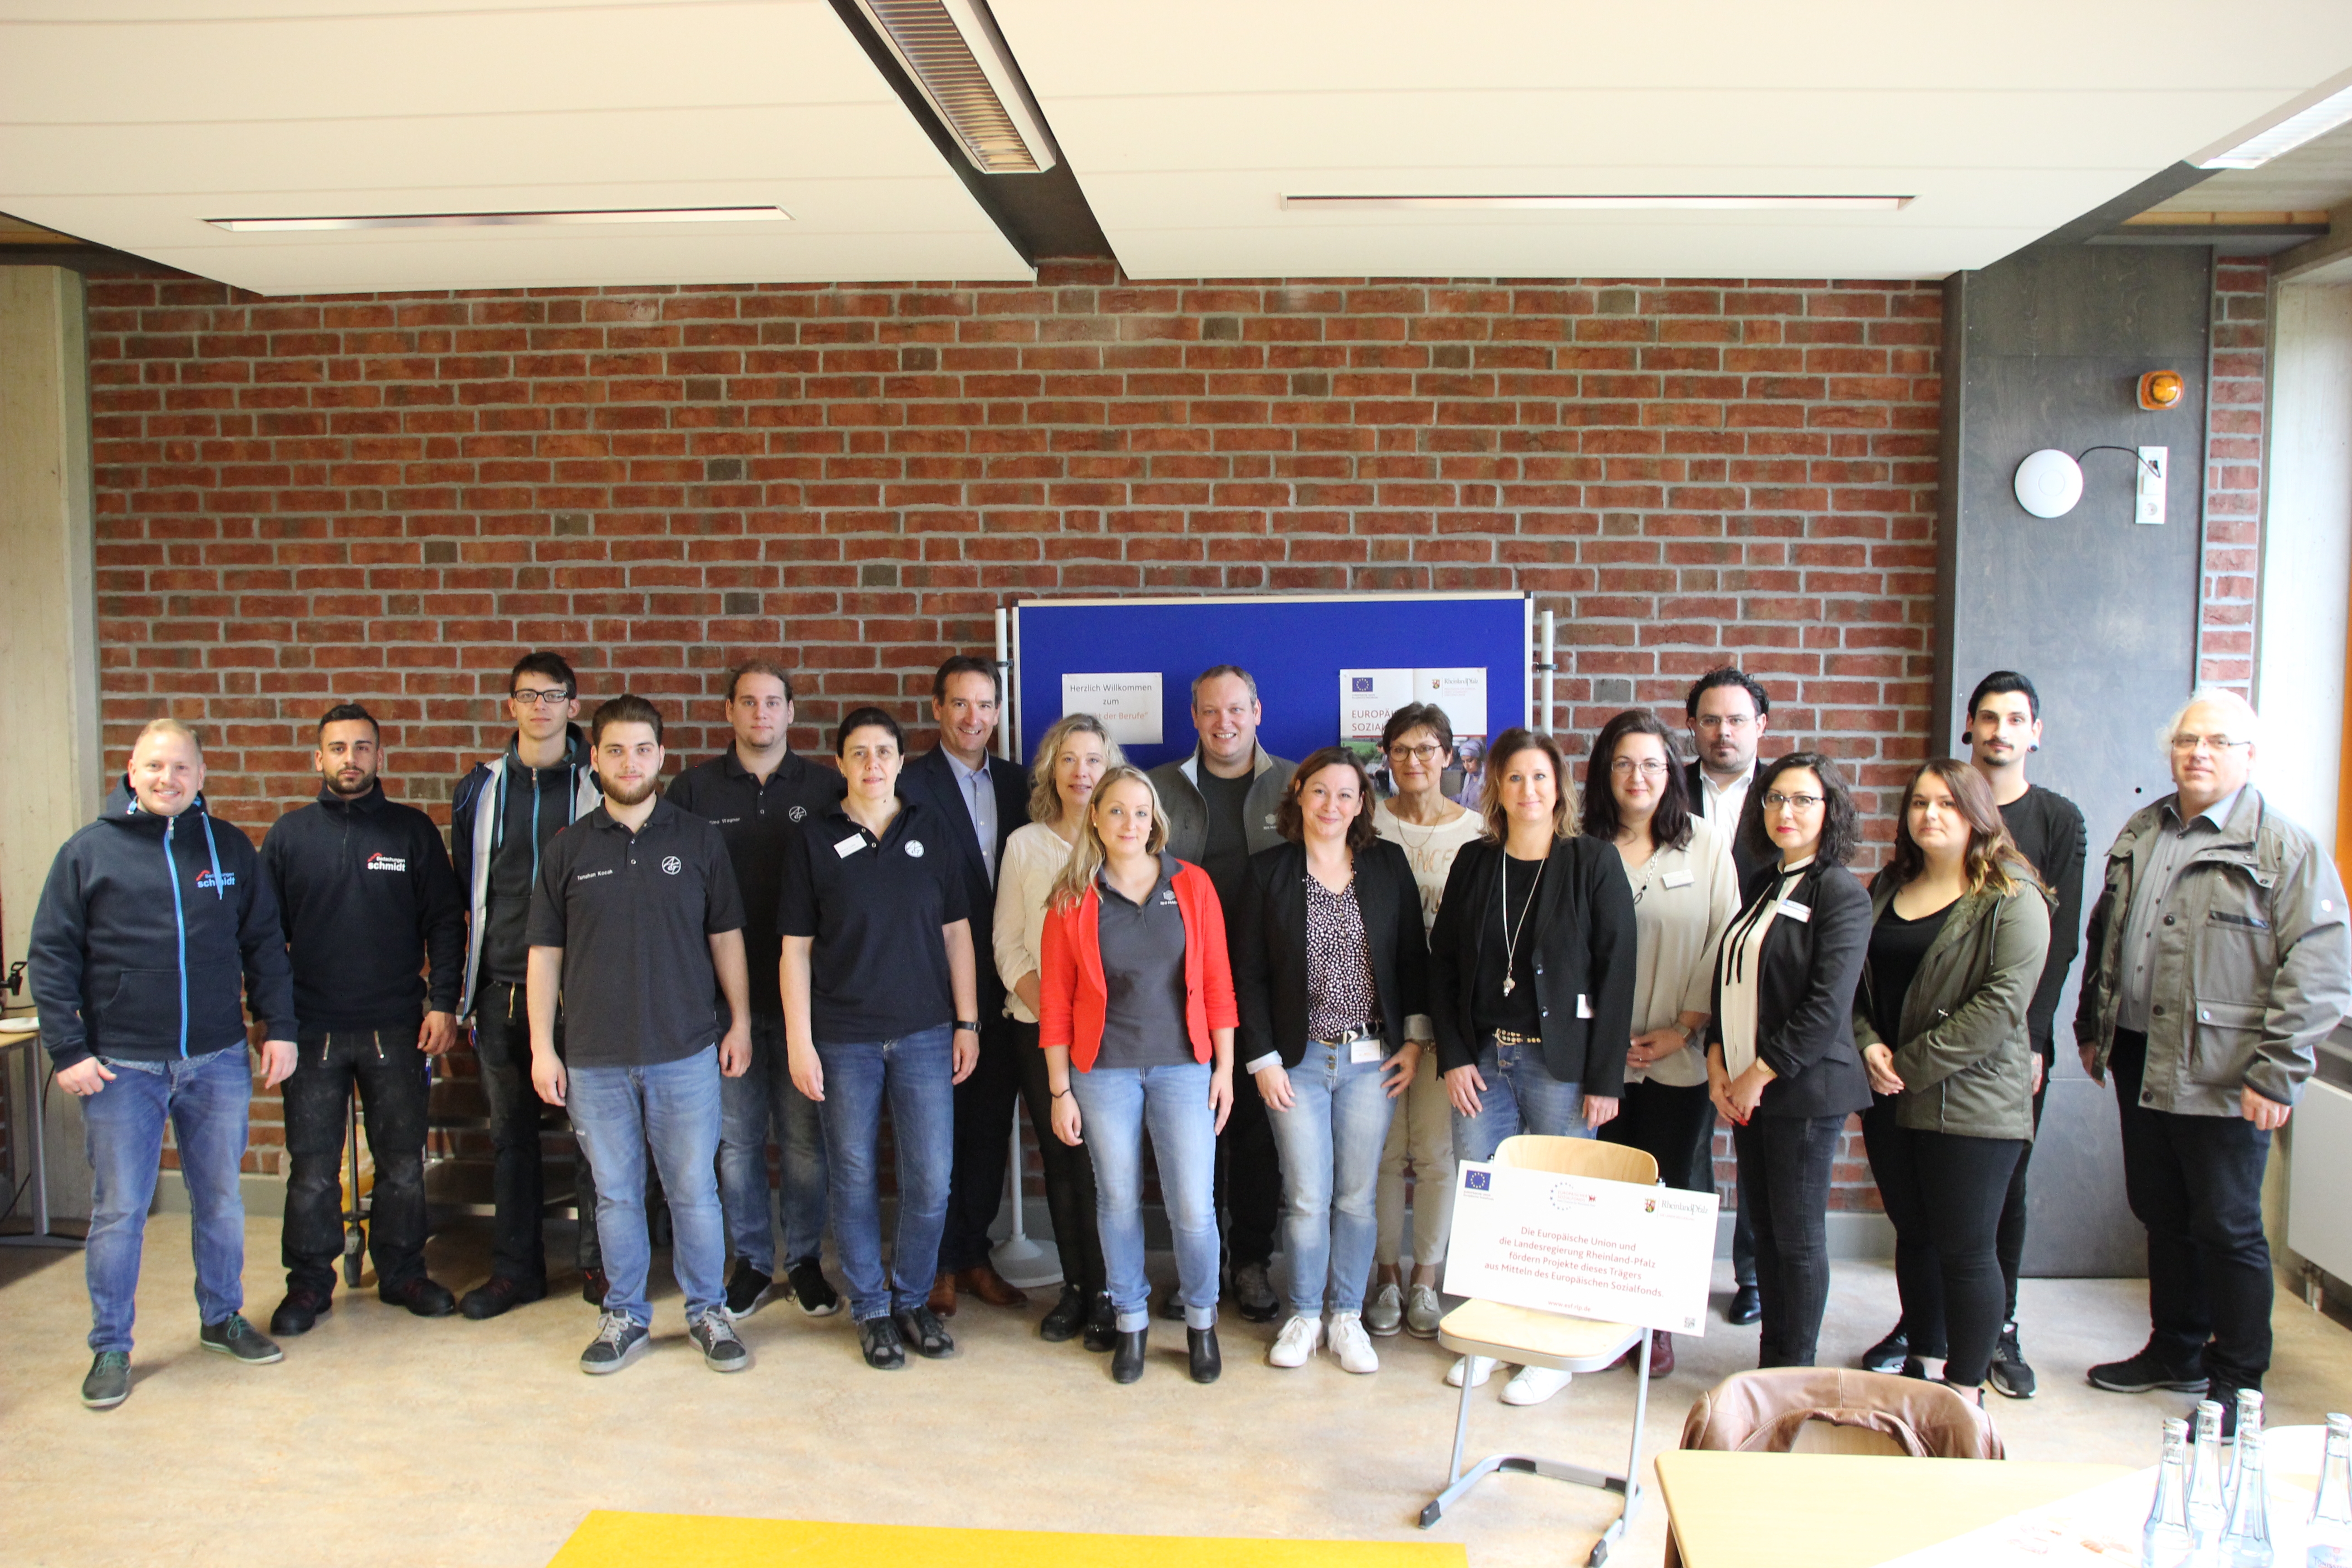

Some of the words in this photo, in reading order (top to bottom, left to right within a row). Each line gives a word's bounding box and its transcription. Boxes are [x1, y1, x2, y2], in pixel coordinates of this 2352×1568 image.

[1070, 684, 1101, 692] Herzlich
[368, 861, 406, 872] schmidt
[197, 877, 235, 888] schidt
[1521, 1226, 1535, 1236] Die
[1538, 1229, 1588, 1244] Europäische
[1591, 1237, 1617, 1249] Union
[1619, 1243, 1636, 1251] und
[1499, 1236, 1511, 1246] die
[1514, 1239, 1583, 1259] Landesregierung
[1586, 1250, 1656, 1268] Rheinland-Pfalz
[1509, 1251, 1540, 1264] fördern
[1543, 1257, 1578, 1269] Projekte
[1581, 1263, 1607, 1274] dieses
[1610, 1267, 1642, 1280] Trägers
[1501, 1264, 1532, 1276] Mitteln
[1534, 1269, 1548, 1279] des
[1552, 1272, 1608, 1288] Europäischen
[1611, 1281, 1664, 1298] Sozialfonds.
